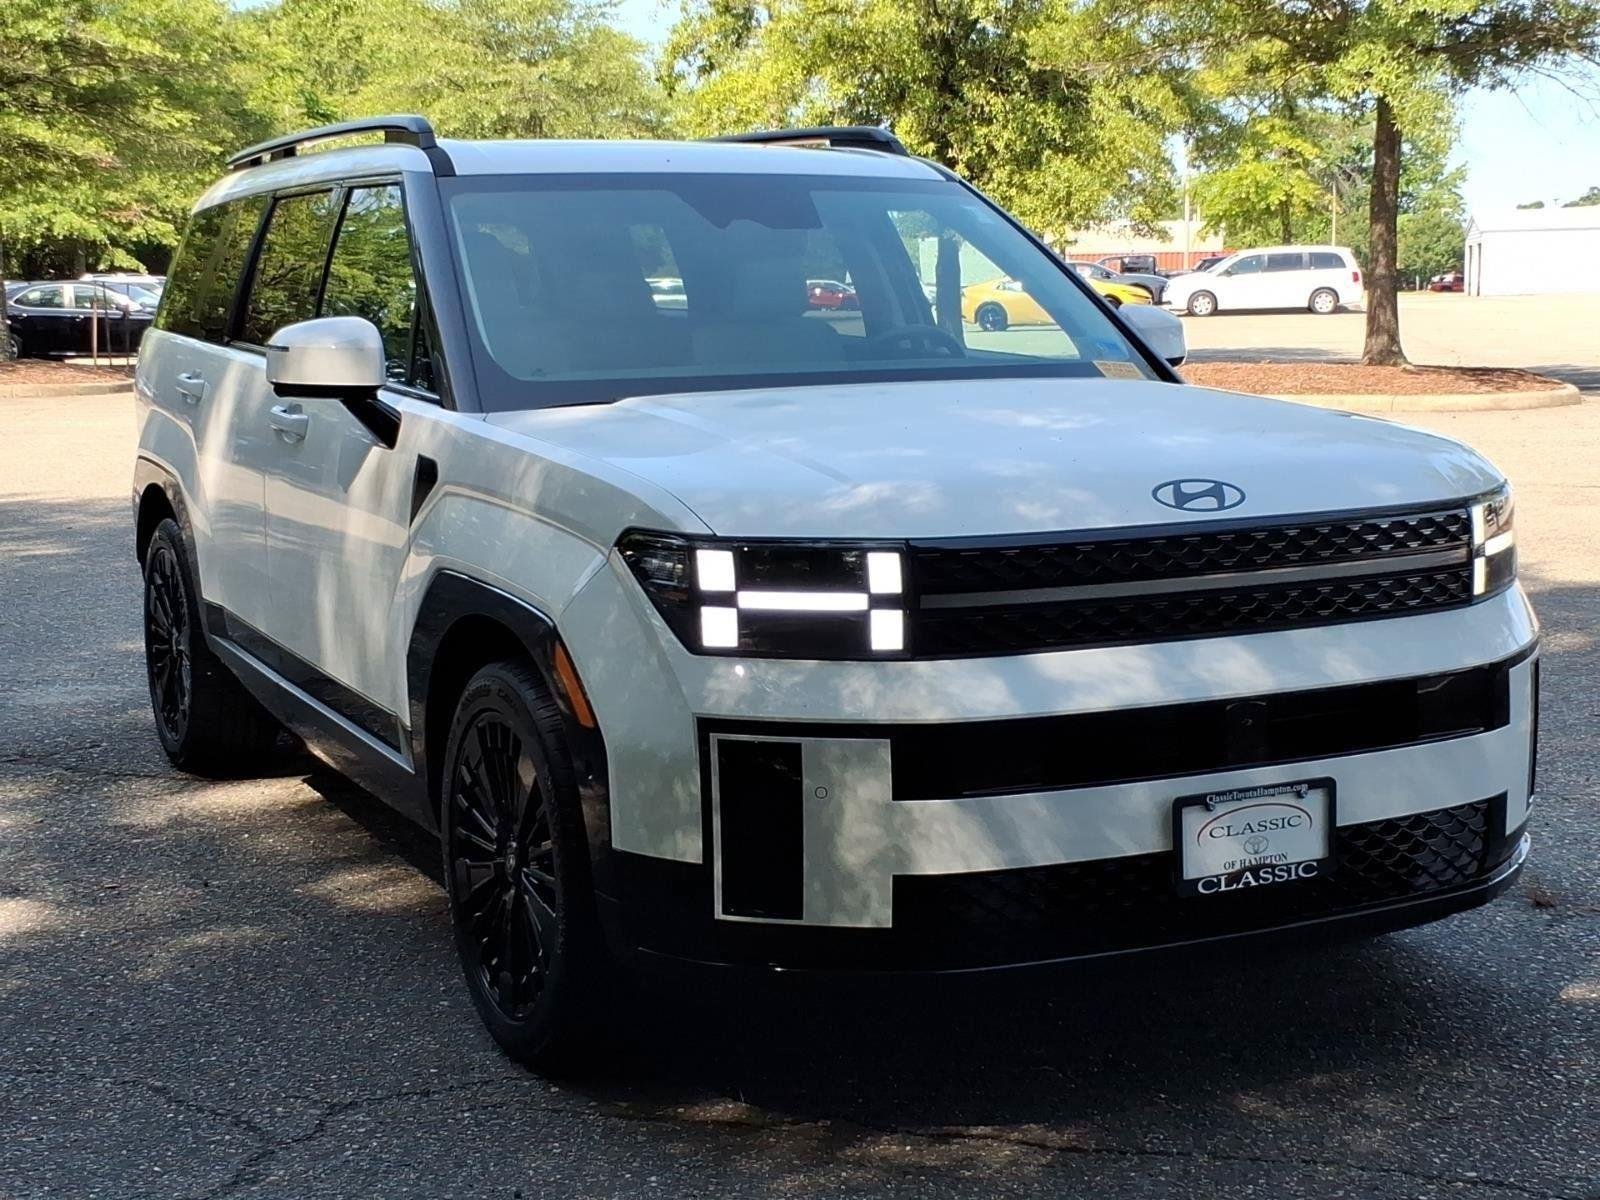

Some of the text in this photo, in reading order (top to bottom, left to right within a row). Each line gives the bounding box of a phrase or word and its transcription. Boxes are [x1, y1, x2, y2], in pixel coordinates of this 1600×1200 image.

[1209, 815, 1302, 839] CLASSIC
[1223, 852, 1289, 871] OF HAMPTON
[1197, 861, 1318, 894] CLASSIC
